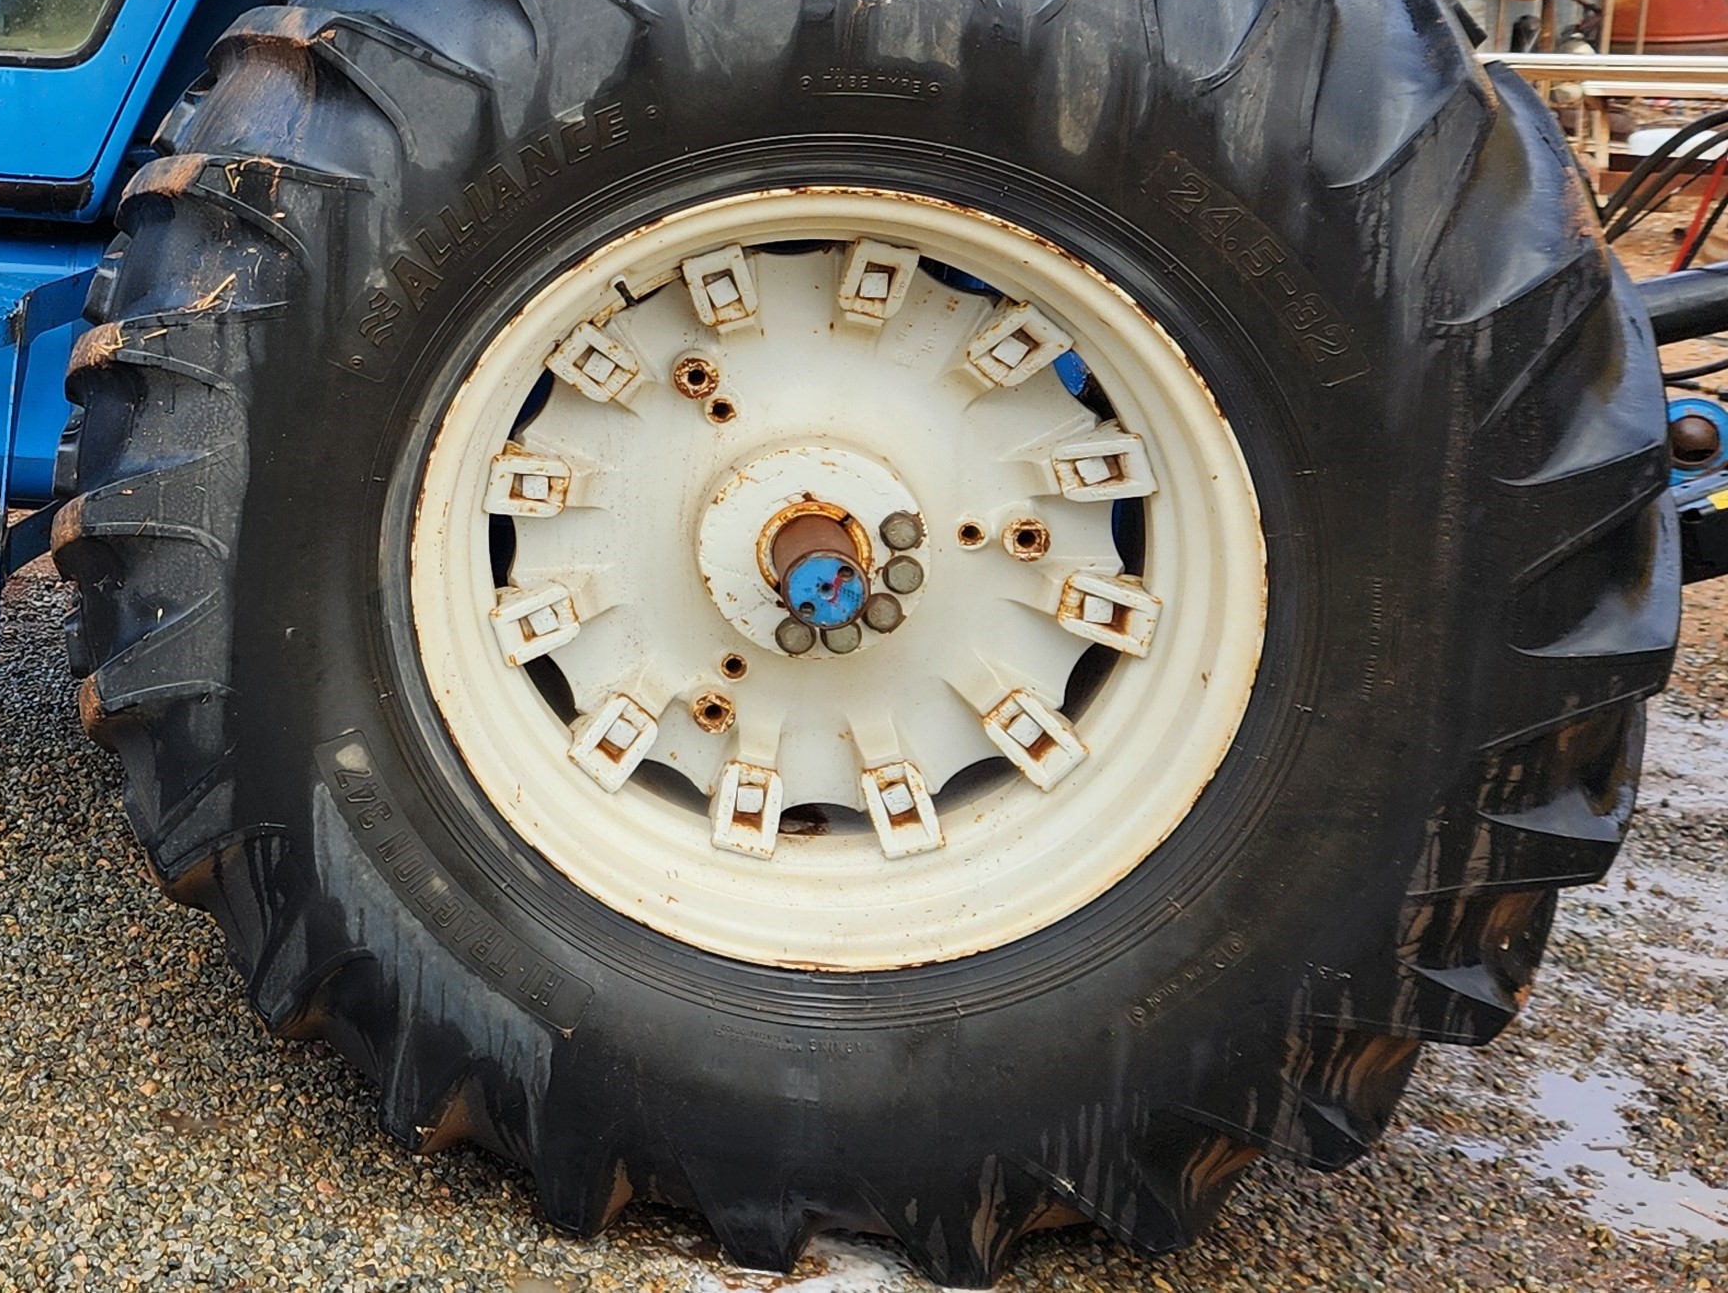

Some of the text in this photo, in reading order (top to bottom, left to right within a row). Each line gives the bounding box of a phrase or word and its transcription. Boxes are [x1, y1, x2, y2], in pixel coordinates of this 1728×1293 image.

[390, 101, 629, 312] ALLIANCE
[1166, 173, 1350, 364] 24.5-32
[333, 767, 394, 831] 347
